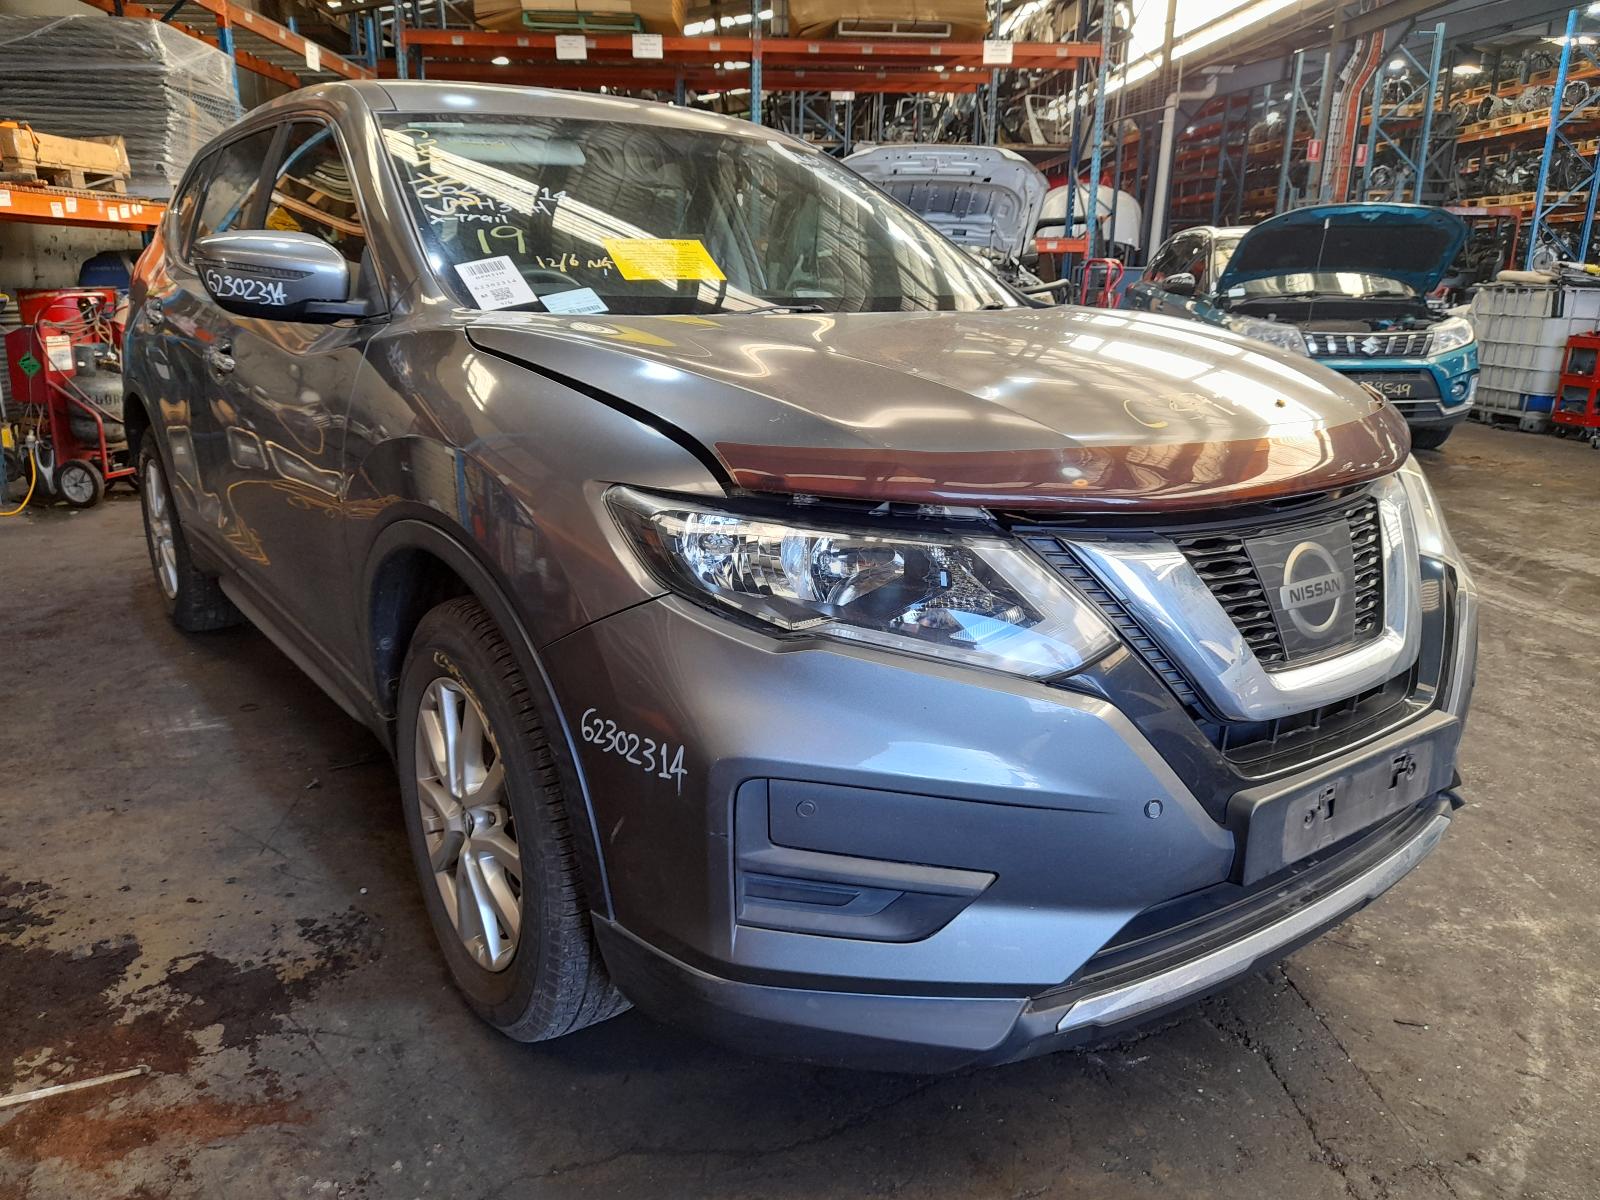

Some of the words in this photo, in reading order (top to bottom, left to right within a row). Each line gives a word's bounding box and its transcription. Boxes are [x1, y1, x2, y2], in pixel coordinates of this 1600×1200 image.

[477, 225, 526, 254] 19
[206, 269, 288, 306] 62302314
[1289, 578, 1341, 604] NISSAN
[581, 707, 688, 796] 62302314
